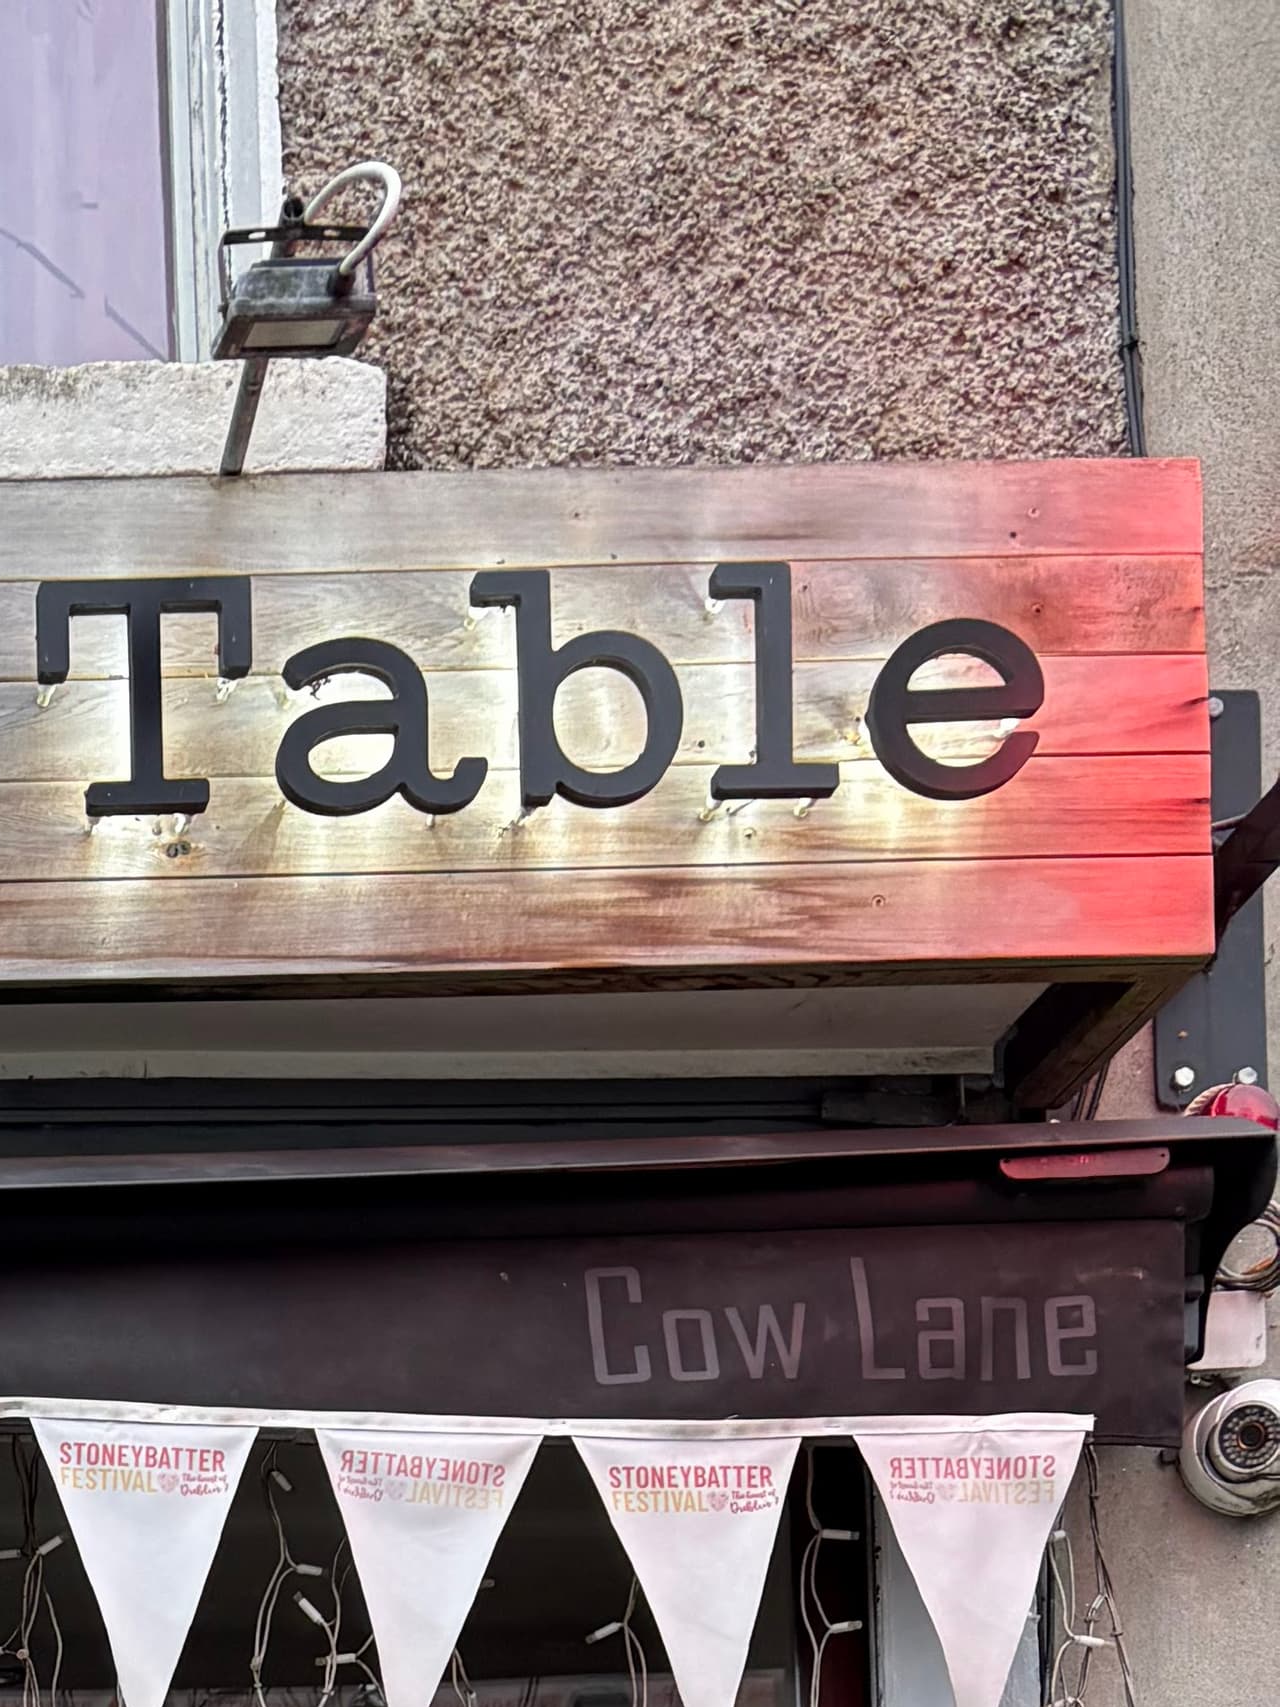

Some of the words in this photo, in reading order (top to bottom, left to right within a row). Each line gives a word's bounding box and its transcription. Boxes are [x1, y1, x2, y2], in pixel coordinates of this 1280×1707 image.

[37, 560, 1045, 818] Table
[584, 1265, 806, 1386] Cow
[850, 1256, 1097, 1381] Lane
[59, 1441, 226, 1473] STONEYBATTER
[59, 1466, 158, 1493] FESTIVAL
[608, 1465, 774, 1489] STONEYBATTER
[611, 1490, 709, 1513] FESTIVAL
